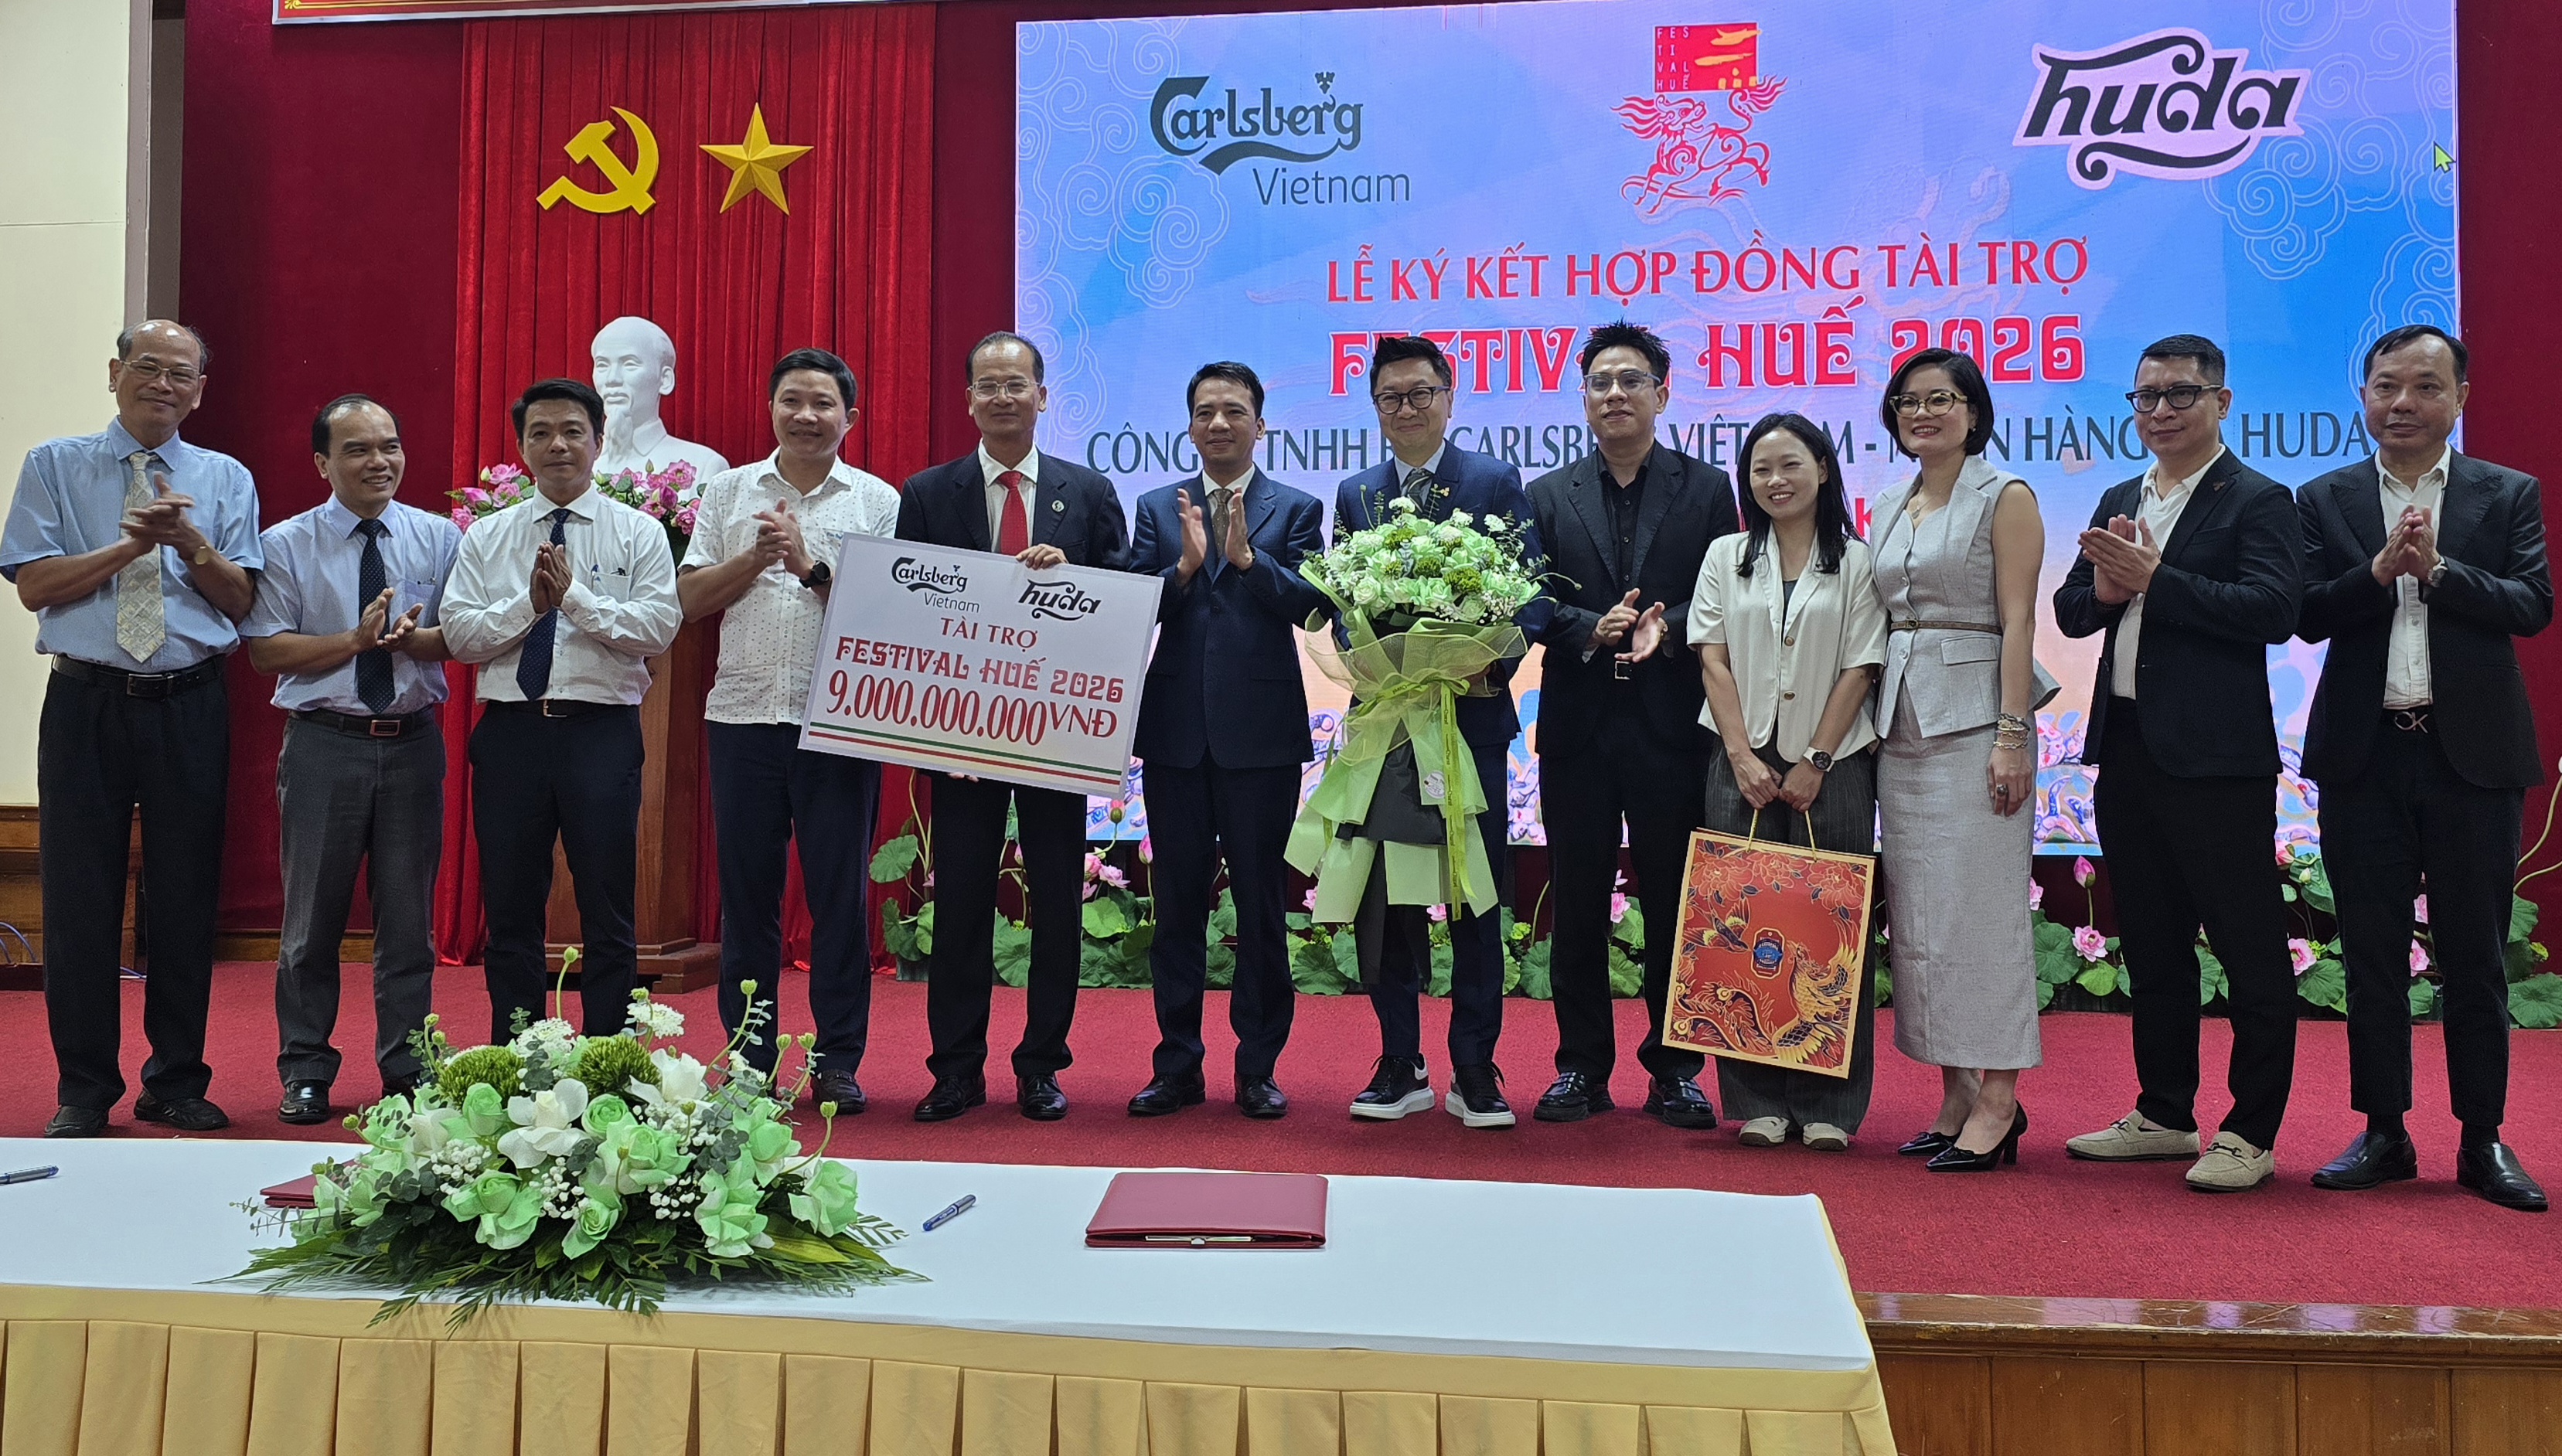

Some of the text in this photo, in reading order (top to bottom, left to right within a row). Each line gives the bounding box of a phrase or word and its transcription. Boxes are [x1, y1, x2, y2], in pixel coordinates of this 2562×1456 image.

[1657, 26, 1689, 39] FES
[1657, 61, 1689, 73] VAL
[1151, 73, 1363, 175] Carlsberg
[2025, 35, 2300, 180] huda
[1252, 167, 1409, 206] Vietnam
[1327, 229, 2088, 307] LỄ KÝ KẾT HỢP ĐỒNG TÀI TRỢ
[1696, 294, 1865, 387] HUẾ
[1890, 315, 2085, 383] 2026
[1086, 422, 1198, 475] CÔNG
[1265, 427, 1367, 471] TNHH
[2241, 411, 2372, 458] HUDA
[891, 556, 968, 594] Carlsberg
[924, 592, 980, 614] Vietnam
[1018, 579, 1102, 621] huda
[940, 616, 1038, 651] TÀI TRỢ
[835, 636, 1124, 703] FESTIVAL HUẾ 2026
